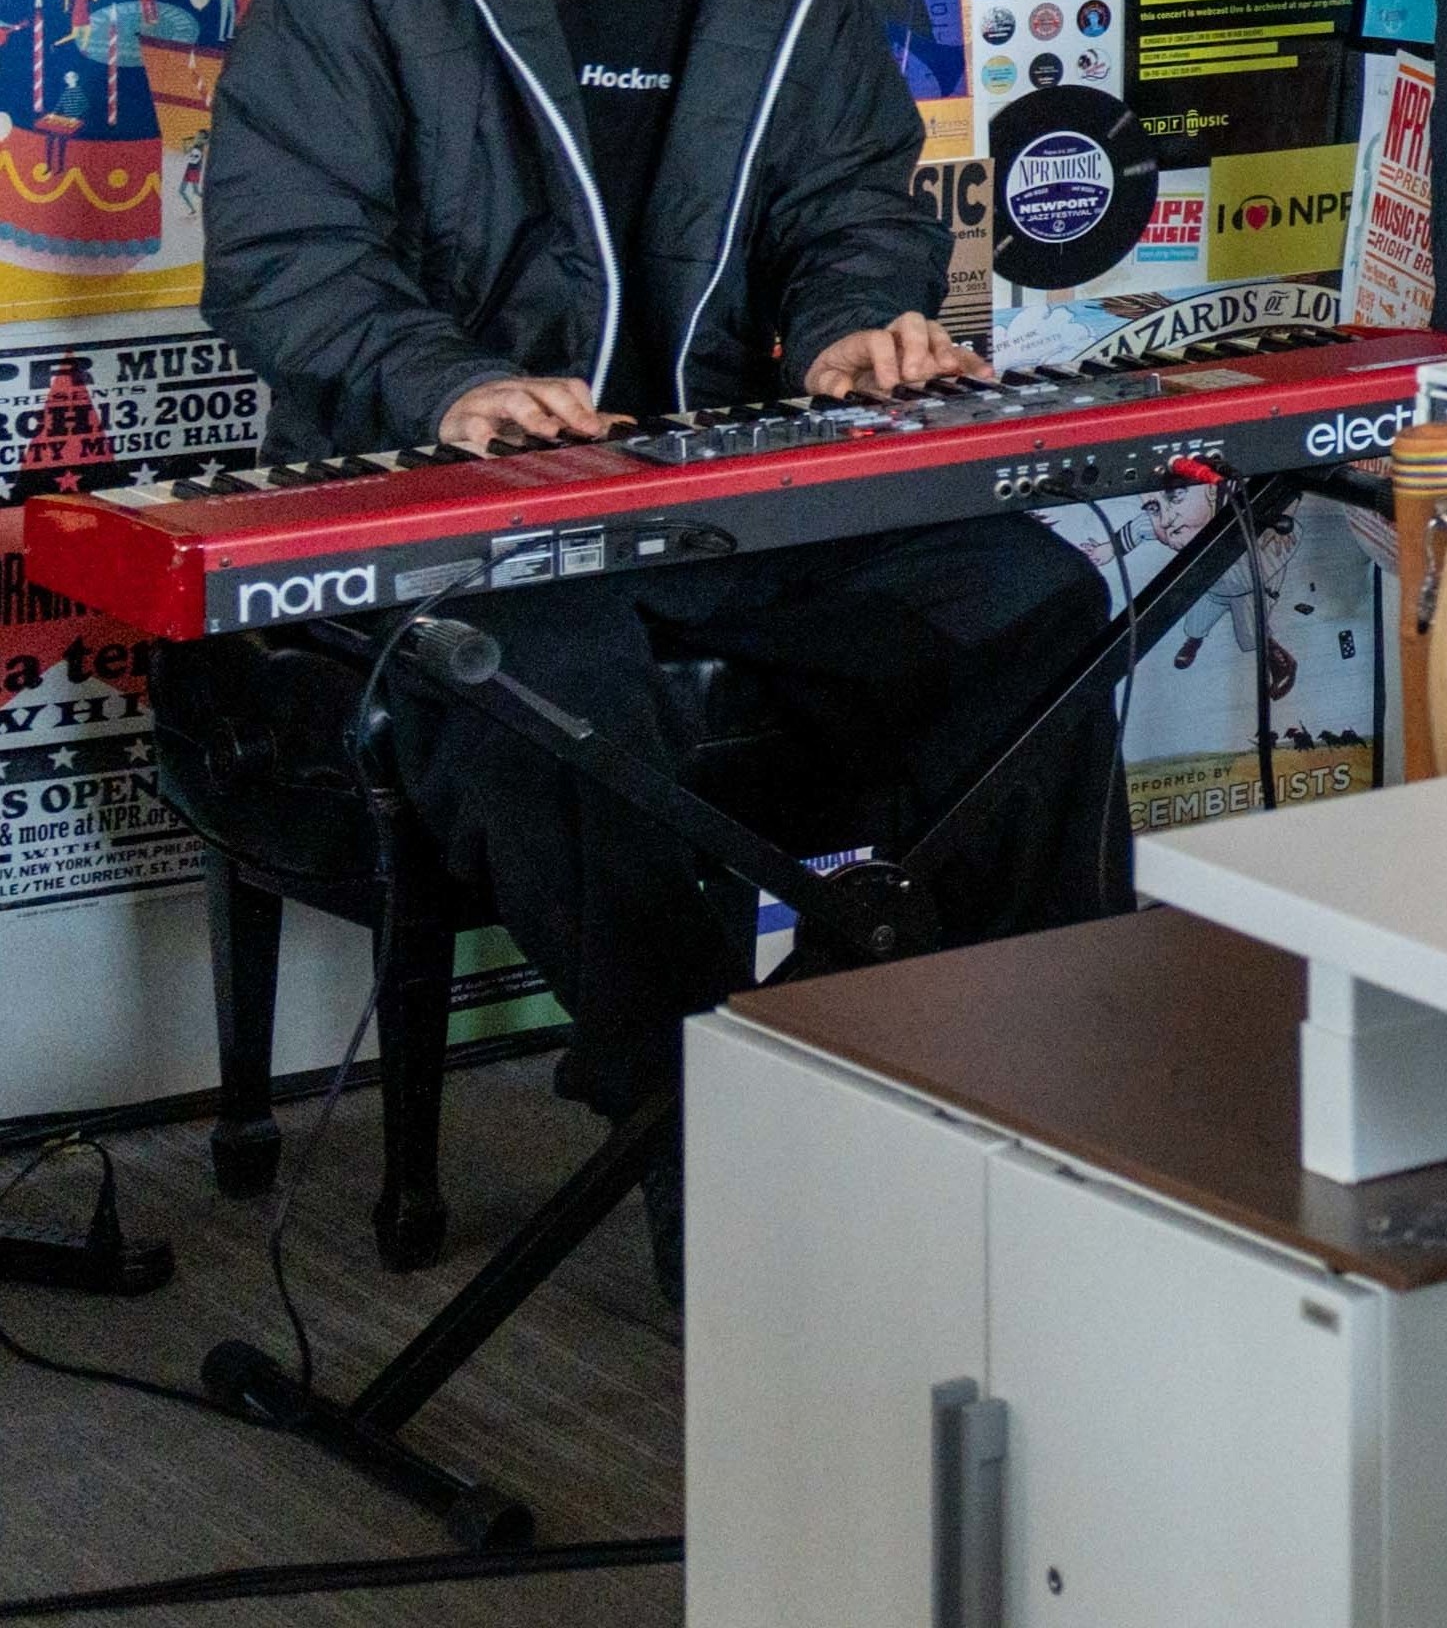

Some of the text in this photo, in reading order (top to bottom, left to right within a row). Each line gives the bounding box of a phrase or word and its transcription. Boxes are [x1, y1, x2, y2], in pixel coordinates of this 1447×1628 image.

[1141, 117, 1183, 137] npr
[1018, 151, 1102, 186] NPR MUSIC
[1019, 196, 1100, 214] NEWPORT
[1026, 208, 1093, 222] JAZZ FESTIVAL
[1371, 192, 1415, 248] MUSIC
[1374, 233, 1412, 265] RIGHT
[100, 387, 258, 432] 13, 2008
[0, 421, 258, 464] CITY MUSIC HALL
[40, 773, 160, 815] OPEN
[17, 809, 182, 844] more at NPR.org
